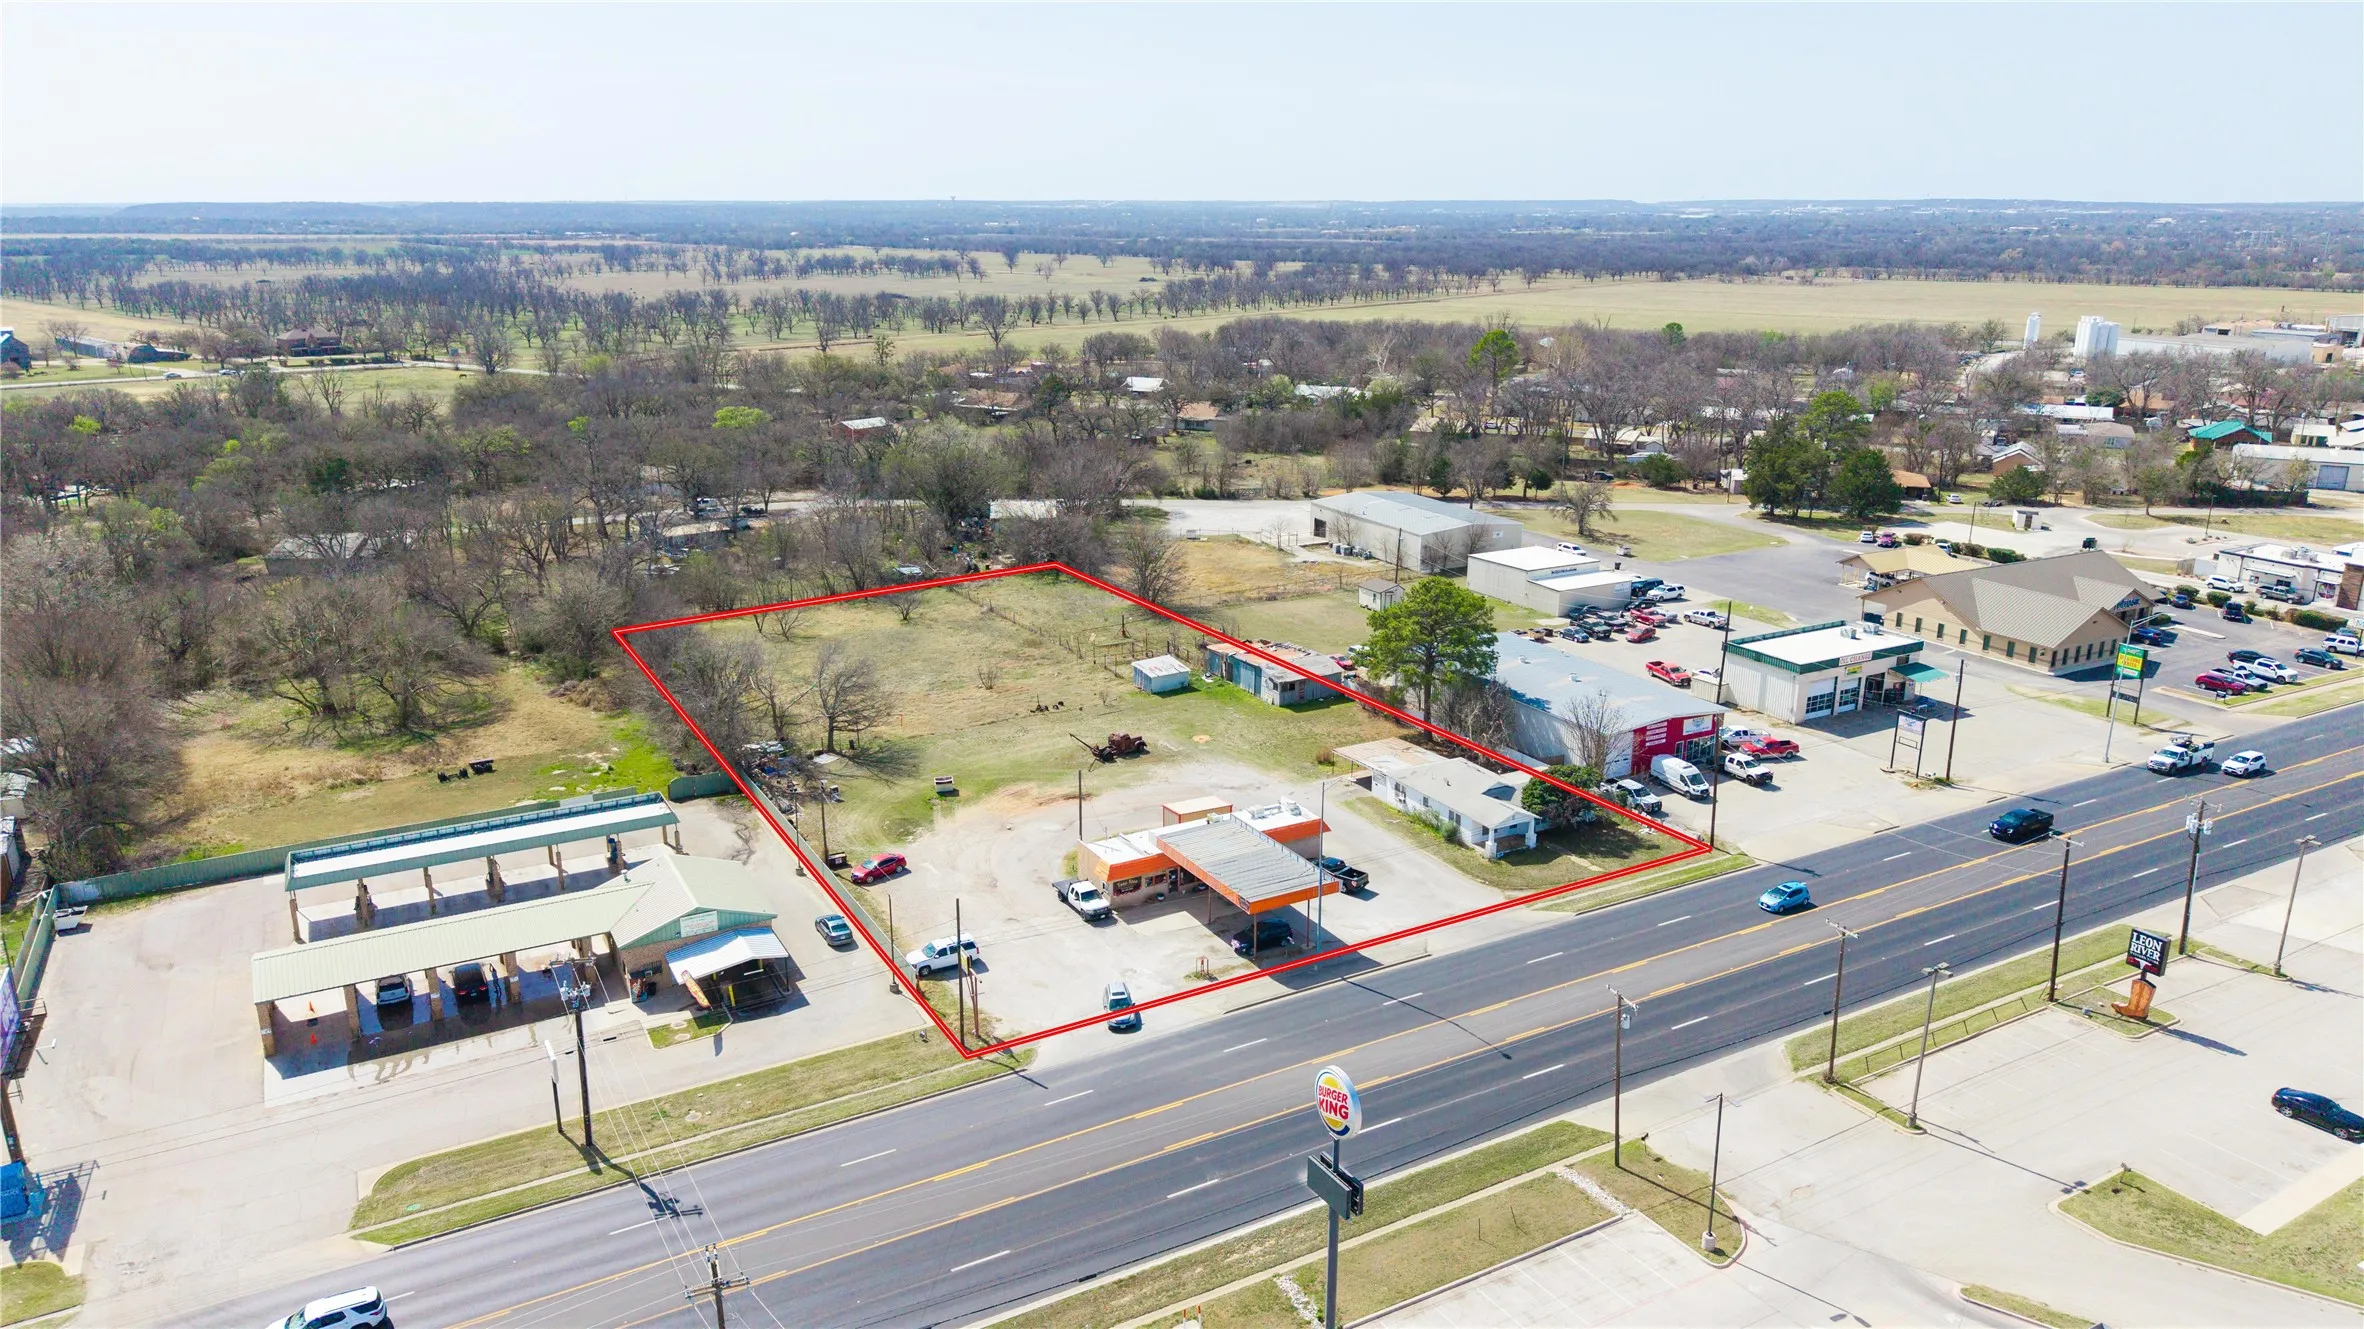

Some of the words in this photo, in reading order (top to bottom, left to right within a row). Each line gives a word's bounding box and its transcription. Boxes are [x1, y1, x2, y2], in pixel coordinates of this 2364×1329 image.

[2130, 942, 2160, 961] RIVER
[2132, 932, 2162, 951] LEON
[1318, 1084, 1348, 1105] BURGER
[1318, 1097, 1349, 1121] KING
